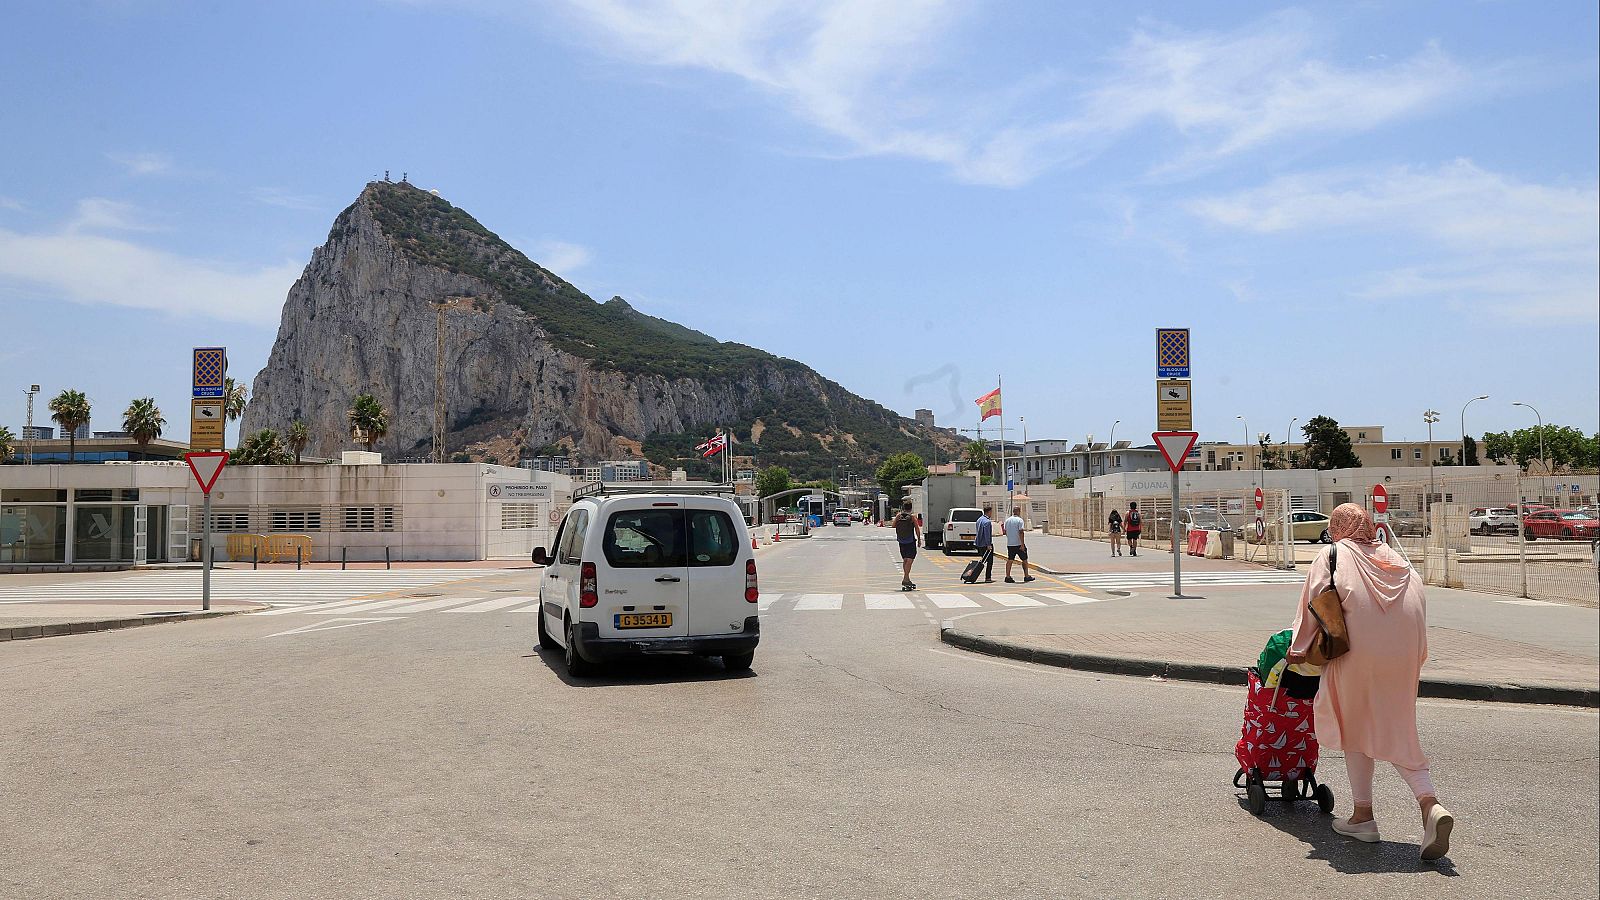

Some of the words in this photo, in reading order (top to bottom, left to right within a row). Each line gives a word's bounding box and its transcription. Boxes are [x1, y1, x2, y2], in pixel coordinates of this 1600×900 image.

[1131, 481, 1169, 490] ADUANA
[624, 615, 631, 626] G
[632, 614, 660, 625] 3534
